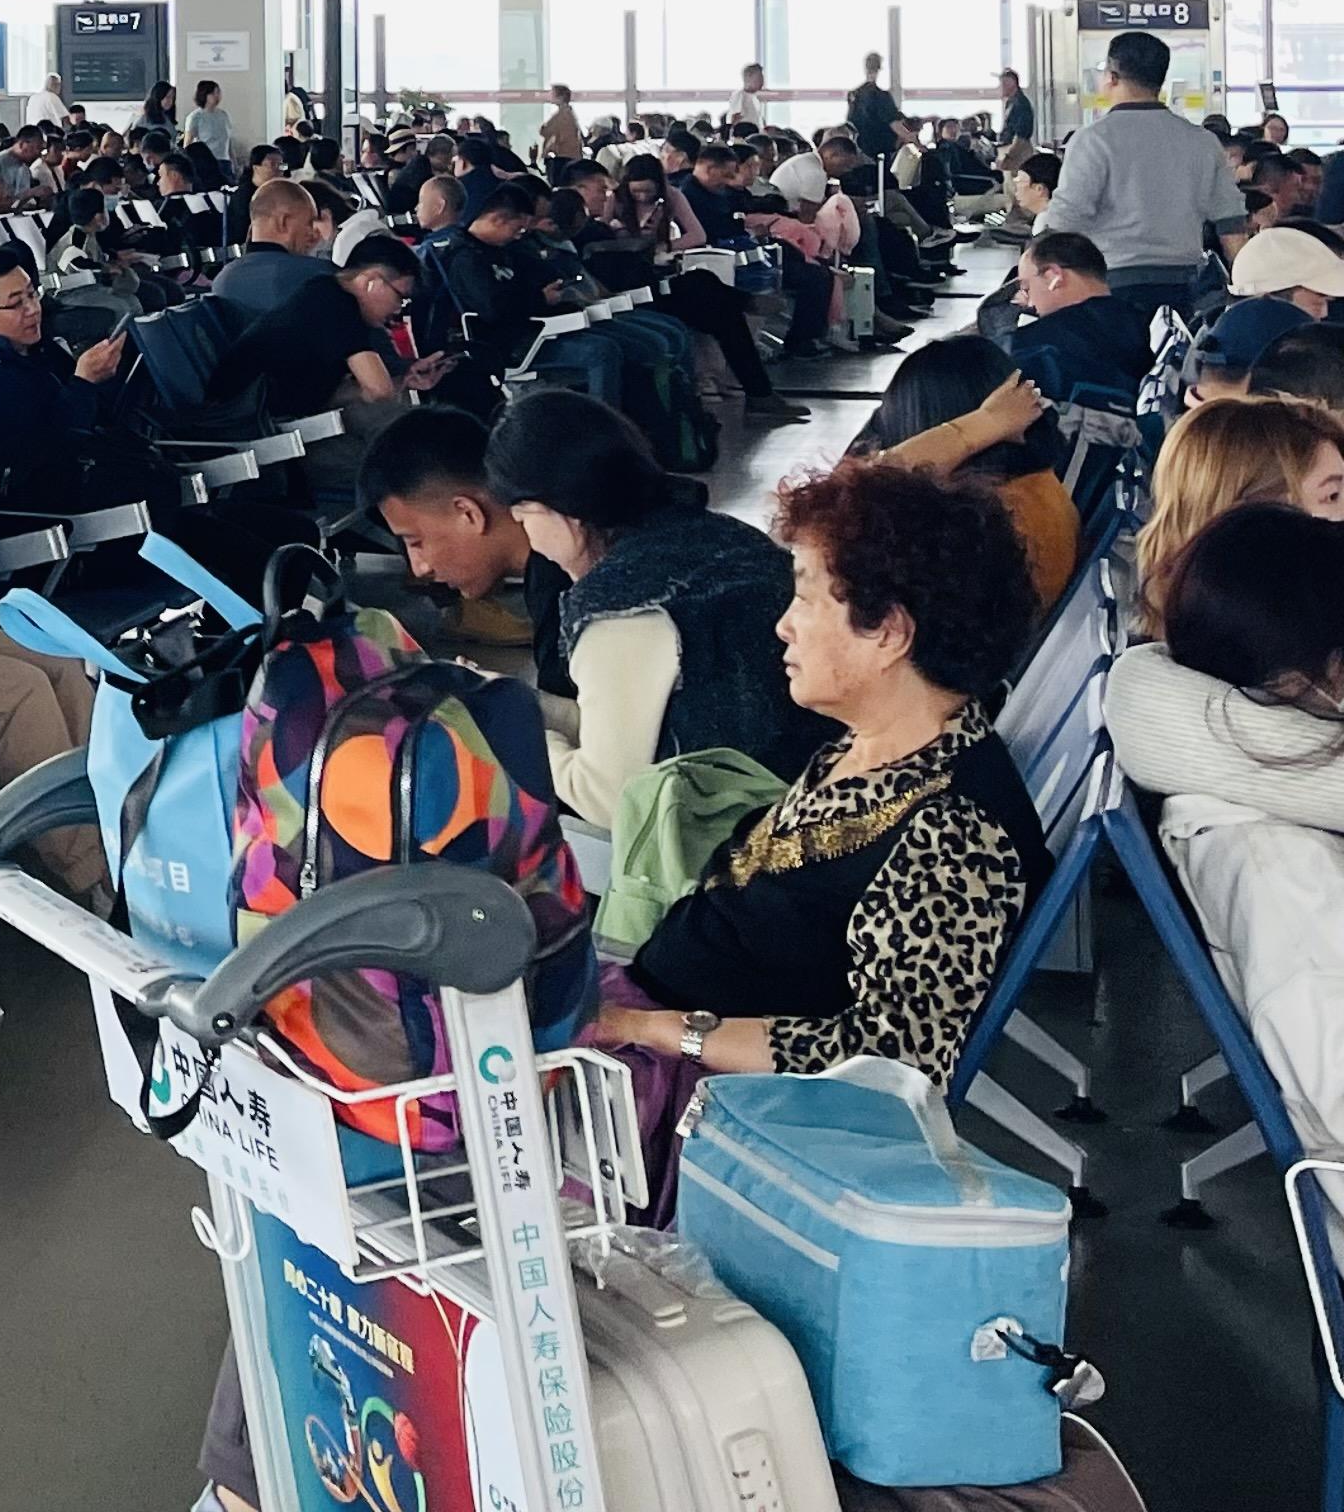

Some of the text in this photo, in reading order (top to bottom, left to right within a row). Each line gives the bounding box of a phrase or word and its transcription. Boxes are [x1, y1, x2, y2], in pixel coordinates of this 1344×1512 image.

[98, 13, 141, 30] 登机口 7
[1129, 3, 1189, 25] 登机口 8
[171, 1042, 272, 1138] 中国人寿
[238, 1128, 281, 1173] LIFE
[487, 1094, 513, 1193] CHINA LIFE
[501, 1090, 532, 1191] 中国人寿
[513, 1220, 585, 1510] 中国人寿保险股份
